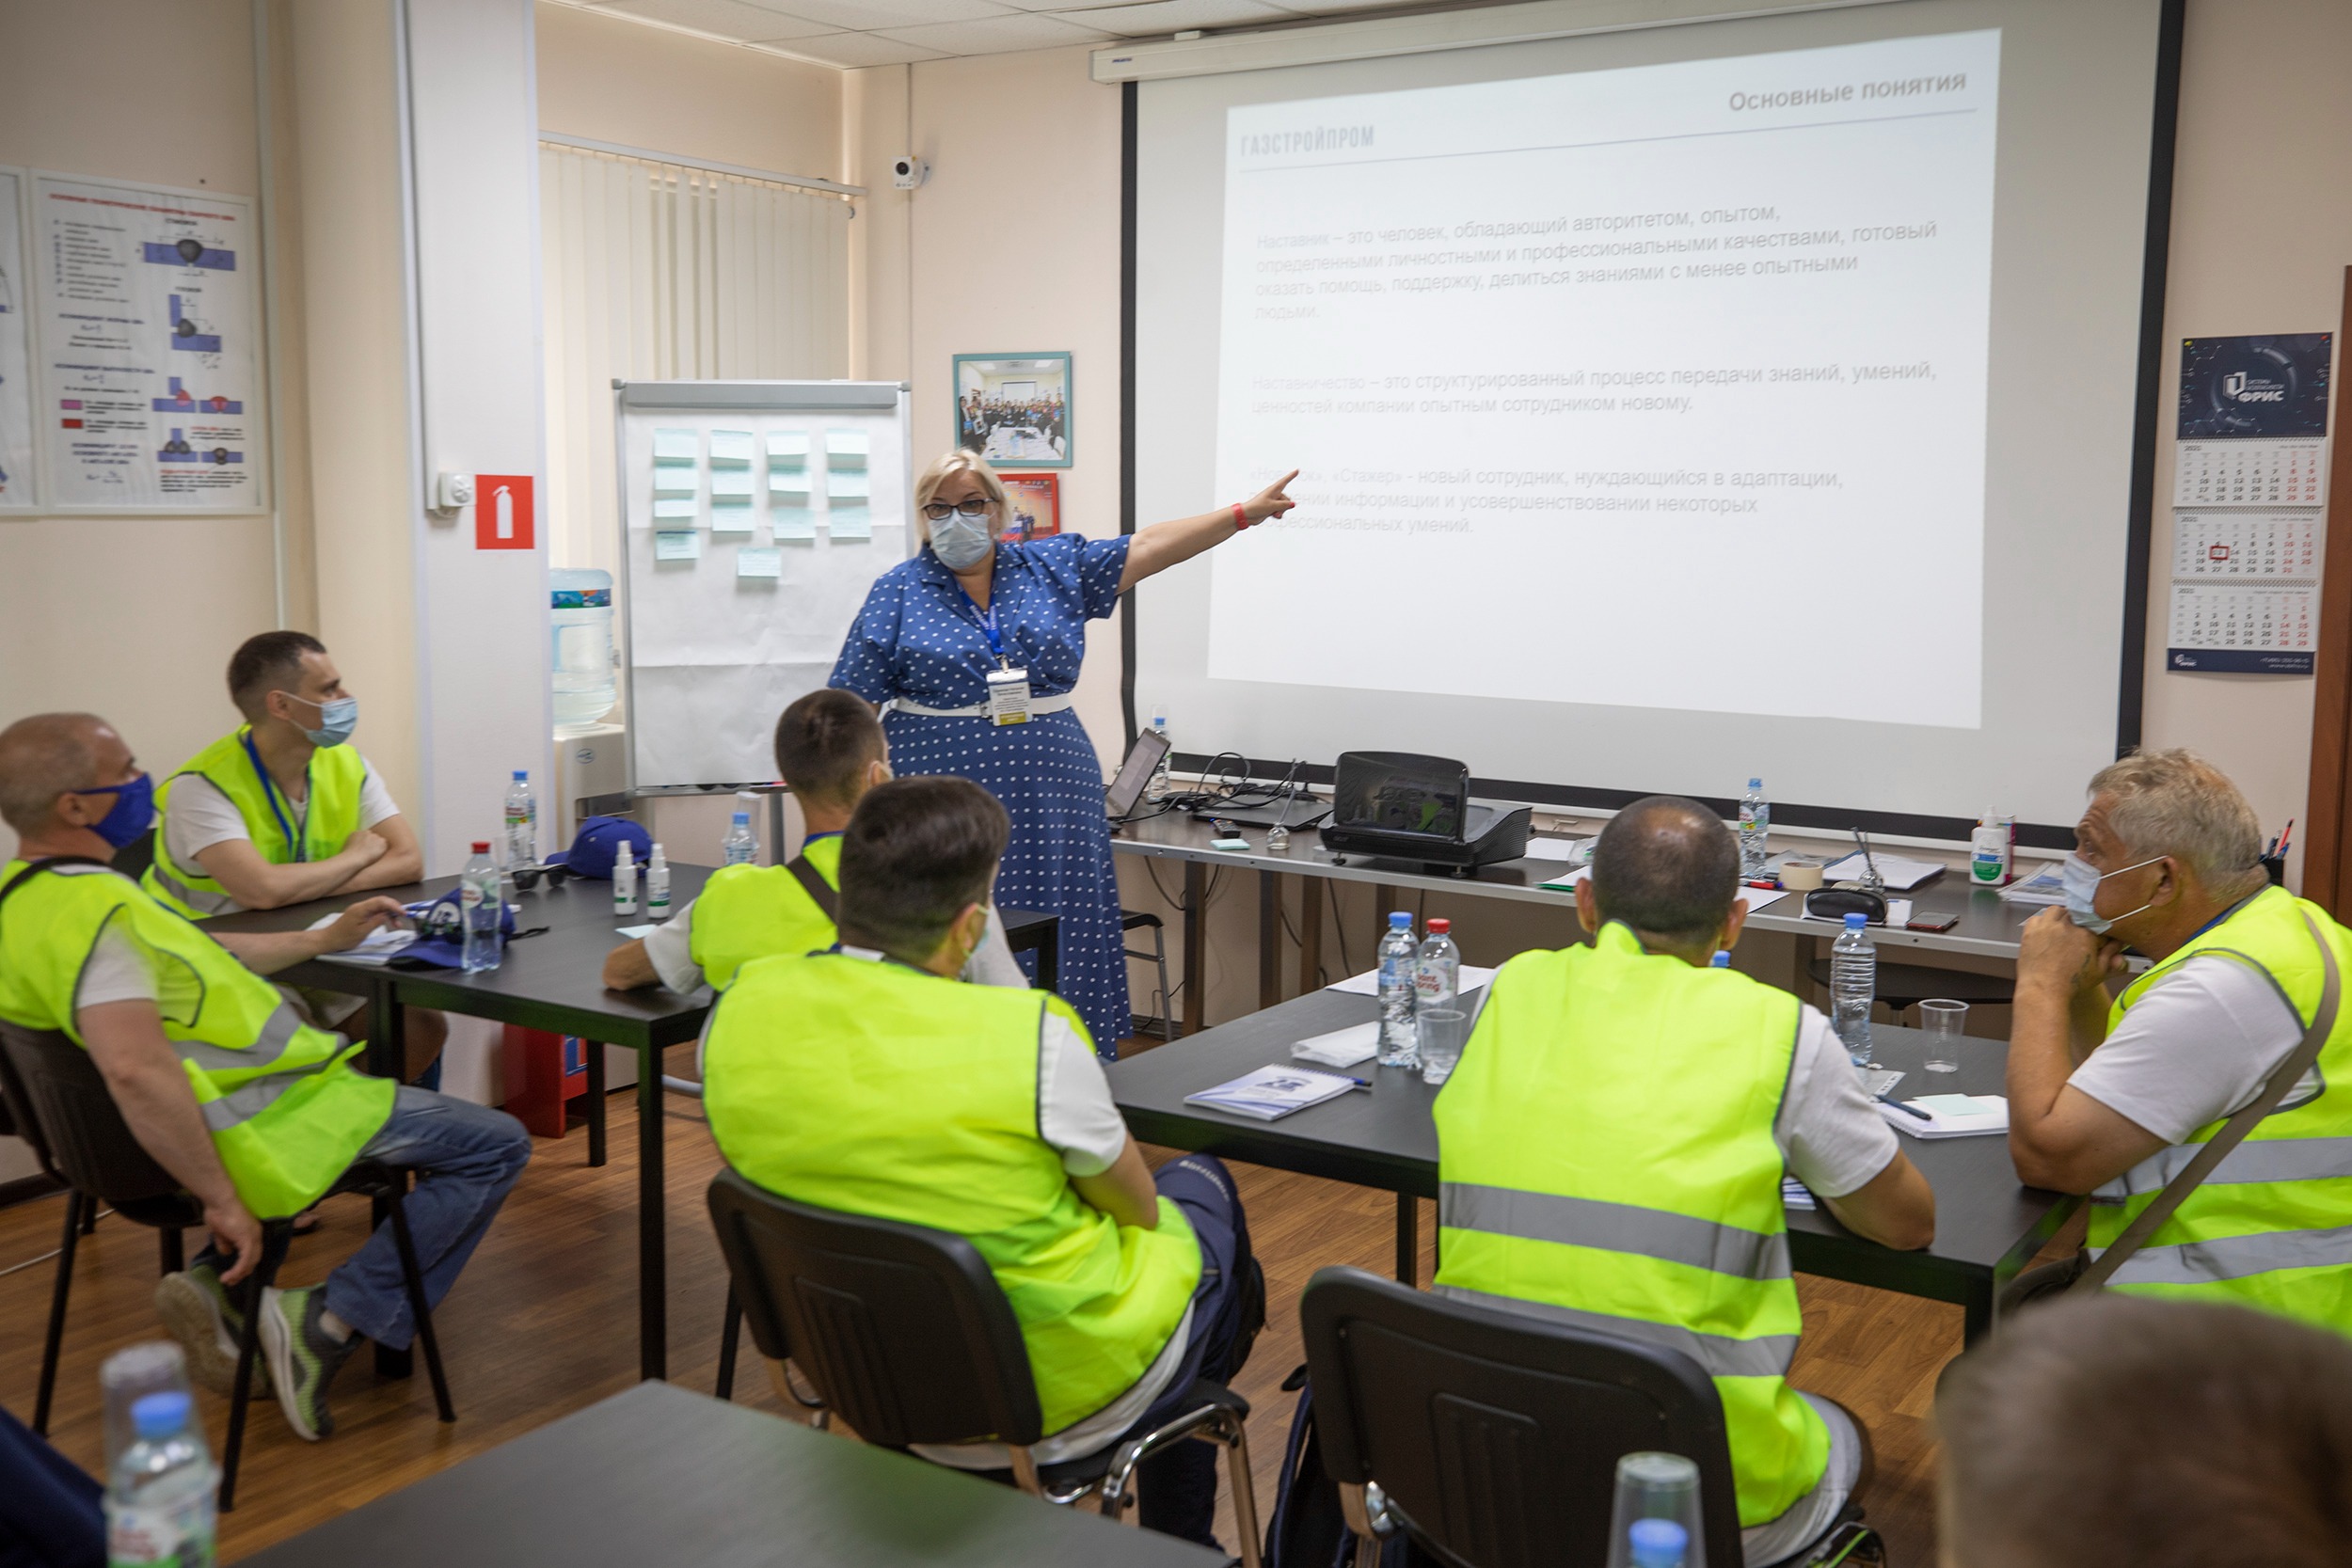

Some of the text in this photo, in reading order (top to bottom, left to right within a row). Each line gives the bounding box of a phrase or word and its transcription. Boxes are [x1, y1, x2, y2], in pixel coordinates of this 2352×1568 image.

[1729, 73, 1967, 111] Основные понятия
[1240, 125, 1375, 156] ГАЗСТРОЙПРОМ
[1348, 231, 1374, 245] это
[1378, 227, 1448, 243] человек,
[1454, 216, 1567, 239] обладающий
[1573, 212, 1694, 233] авторитетом,
[1700, 207, 1780, 224] опытом,
[1256, 220, 1938, 276] определенными личностными и профессиональными качествами, готовый
[1255, 282, 1314, 296] оказать
[1488, 271, 1570, 290] делиться
[1576, 266, 1664, 283] знаниями
[1670, 265, 1681, 278] с
[1686, 262, 1747, 277] менее
[1752, 256, 1859, 275] опытными
[1385, 376, 1410, 389] это
[1416, 370, 1584, 391] структурированный
[1591, 372, 1665, 388] процесс
[1671, 370, 1763, 388] передачи
[1769, 364, 1846, 383] знаний,
[1851, 361, 1937, 385] умений,
[1251, 397, 1693, 416] ценностей компании опытным сотрудником новому.
[2238, 390, 2284, 403] ФРИС
[1419, 468, 1470, 483] новый
[1476, 471, 1569, 488] сотрудник,
[1575, 469, 1708, 488] нуждающийся
[1714, 473, 1724, 485] в
[1730, 473, 1844, 489] адаптации,
[1335, 491, 1439, 511] информации
[1445, 496, 1454, 508] и
[1460, 496, 1650, 513] усовершенствовании
[1656, 499, 1757, 515] некоторых
[1407, 517, 1473, 535] умений.
